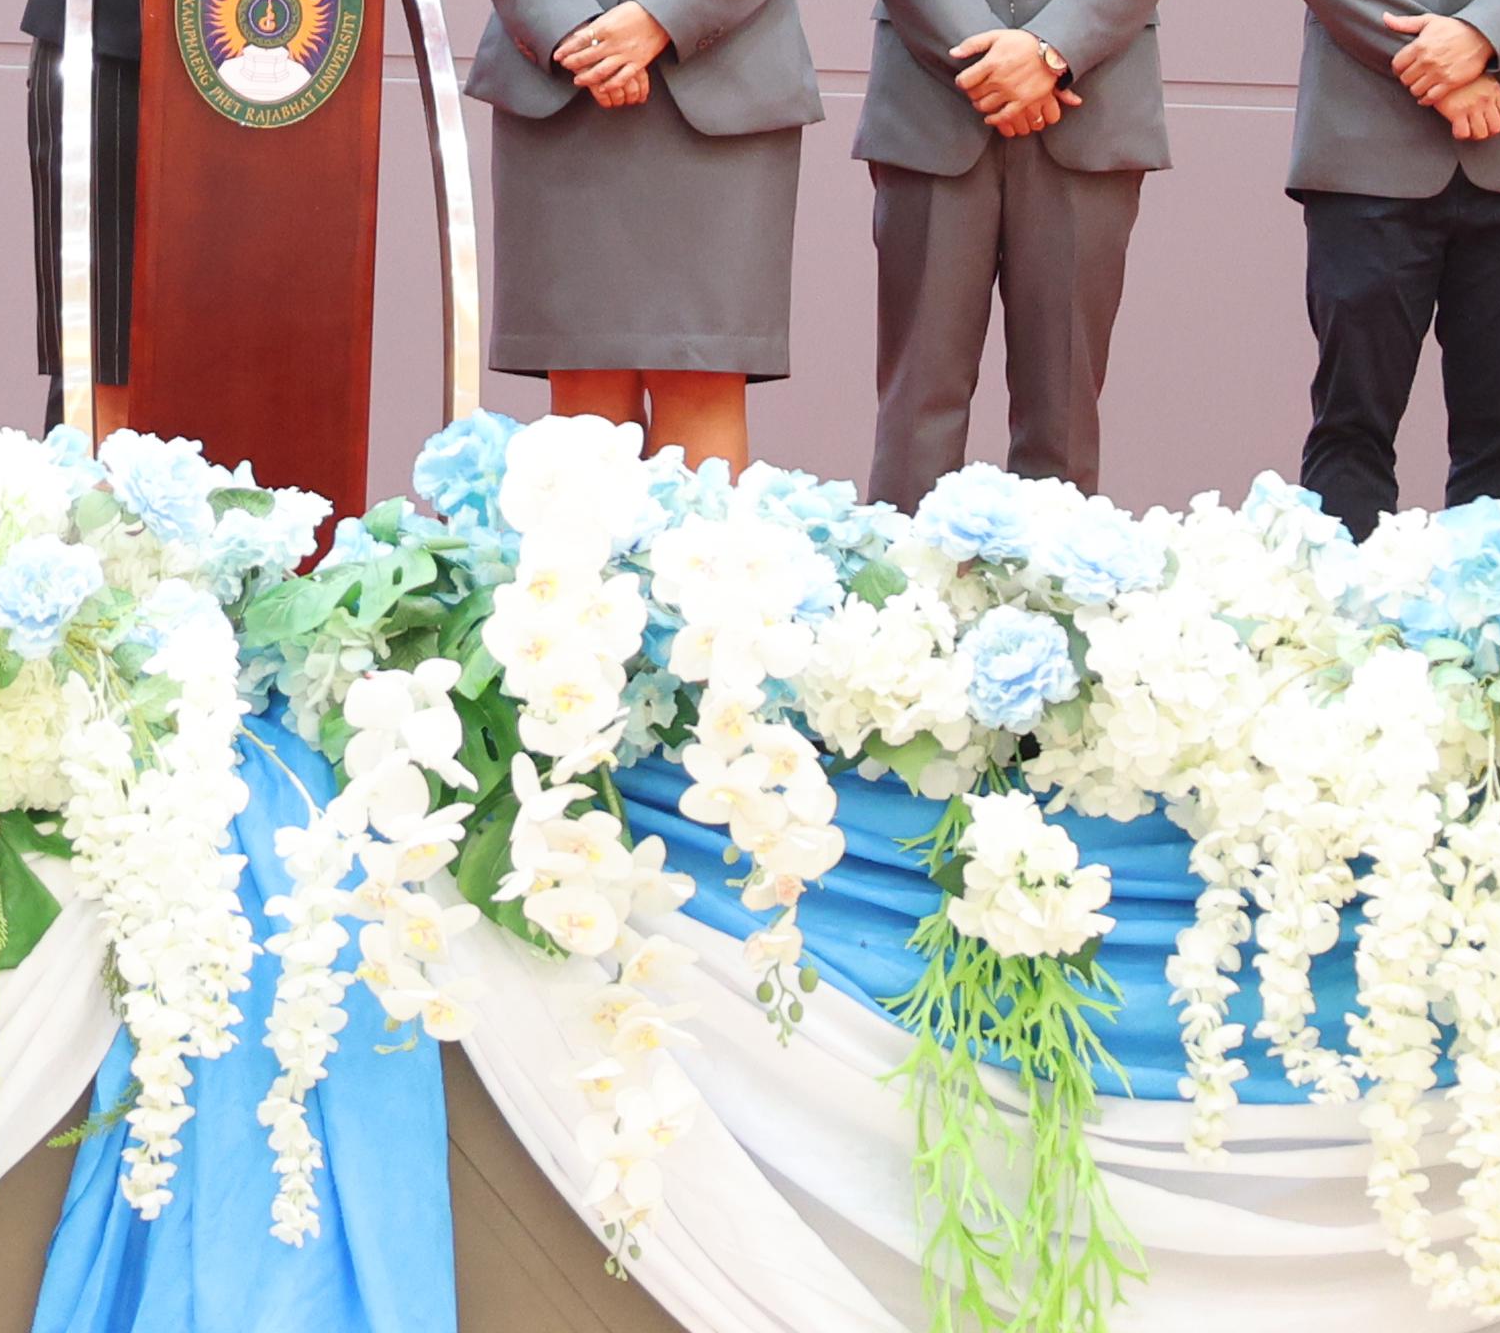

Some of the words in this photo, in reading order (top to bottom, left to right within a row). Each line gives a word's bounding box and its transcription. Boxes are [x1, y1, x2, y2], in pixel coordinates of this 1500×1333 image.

[208, 86, 242, 115] PHET
[244, 92, 318, 124] RAJABHAT
[315, 10, 358, 94] UNIVERSITY
